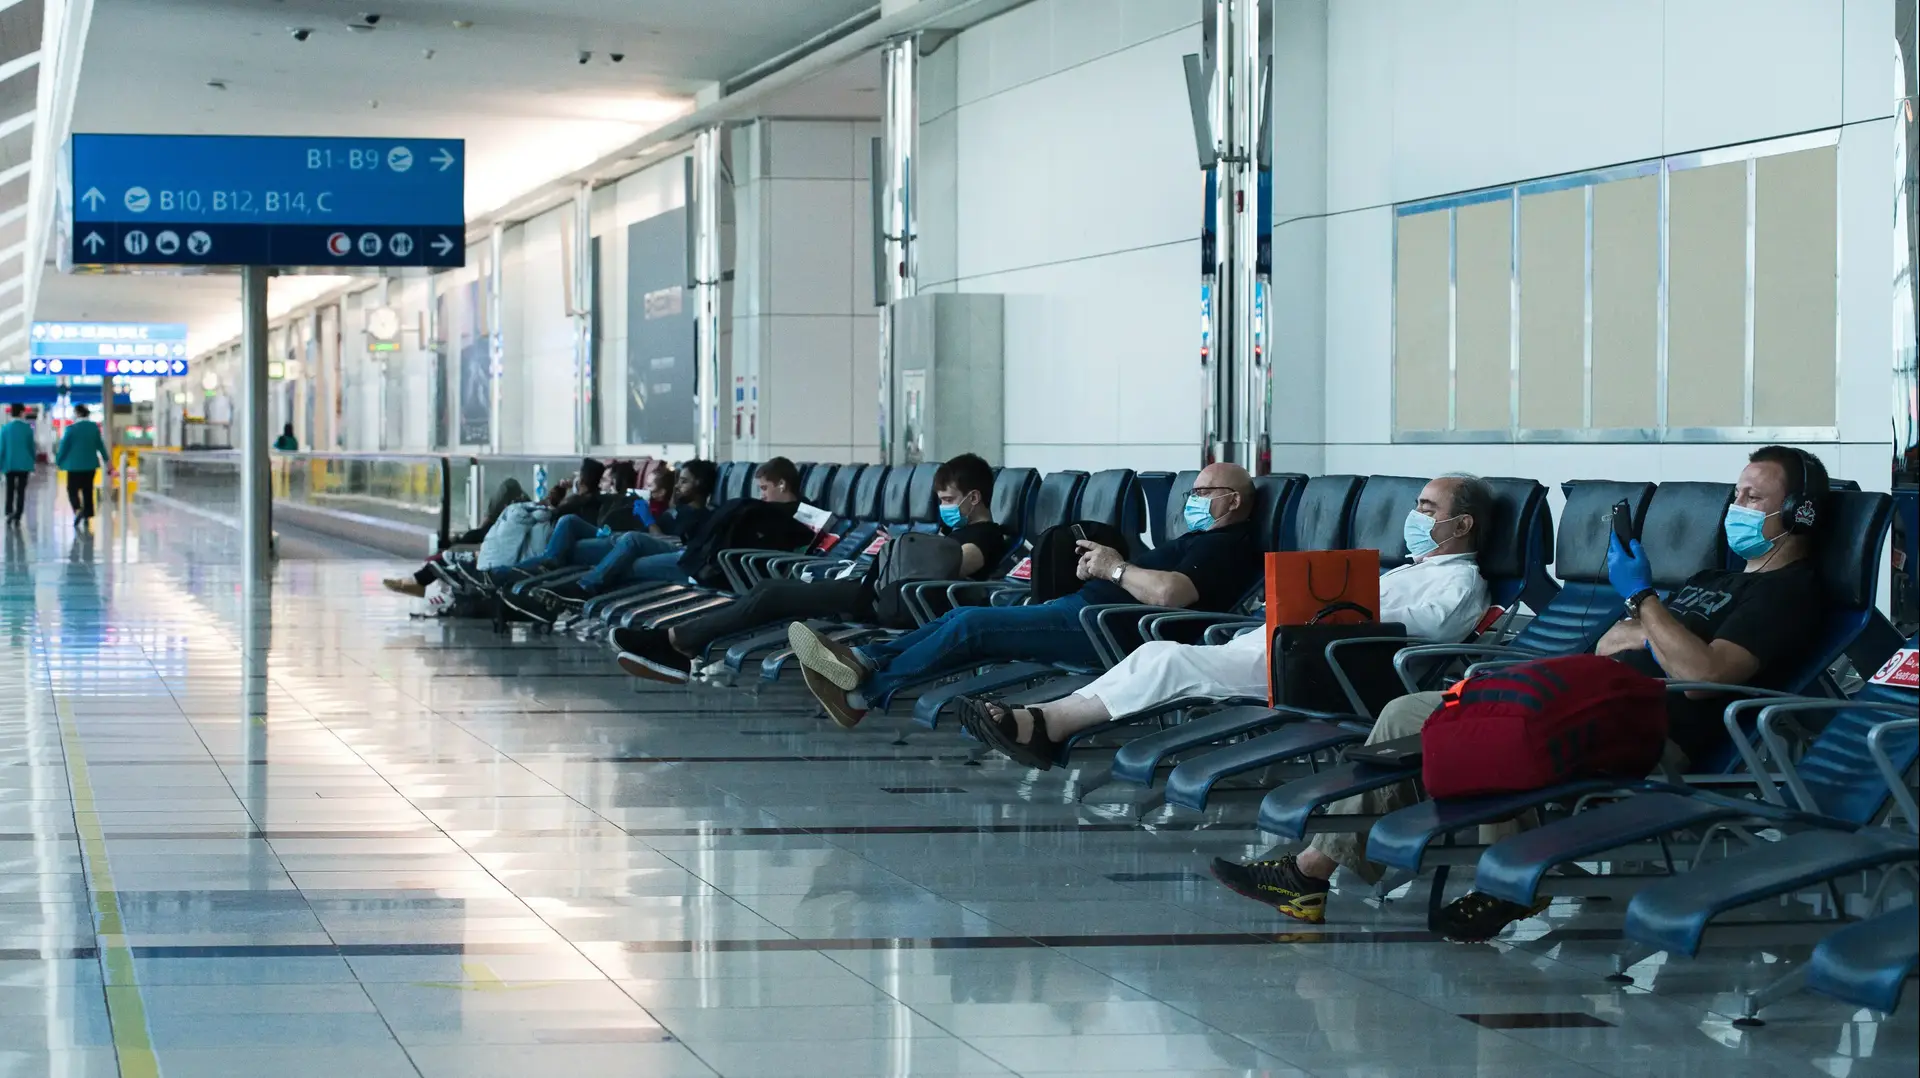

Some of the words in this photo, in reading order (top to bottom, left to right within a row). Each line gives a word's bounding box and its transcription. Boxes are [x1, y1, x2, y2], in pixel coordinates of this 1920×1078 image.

[160, 190, 206, 215] B10,
[213, 190, 259, 215] B12,
[266, 190, 311, 215] B14,
[317, 192, 333, 212] C
[1892, 670, 1910, 680] Seats
